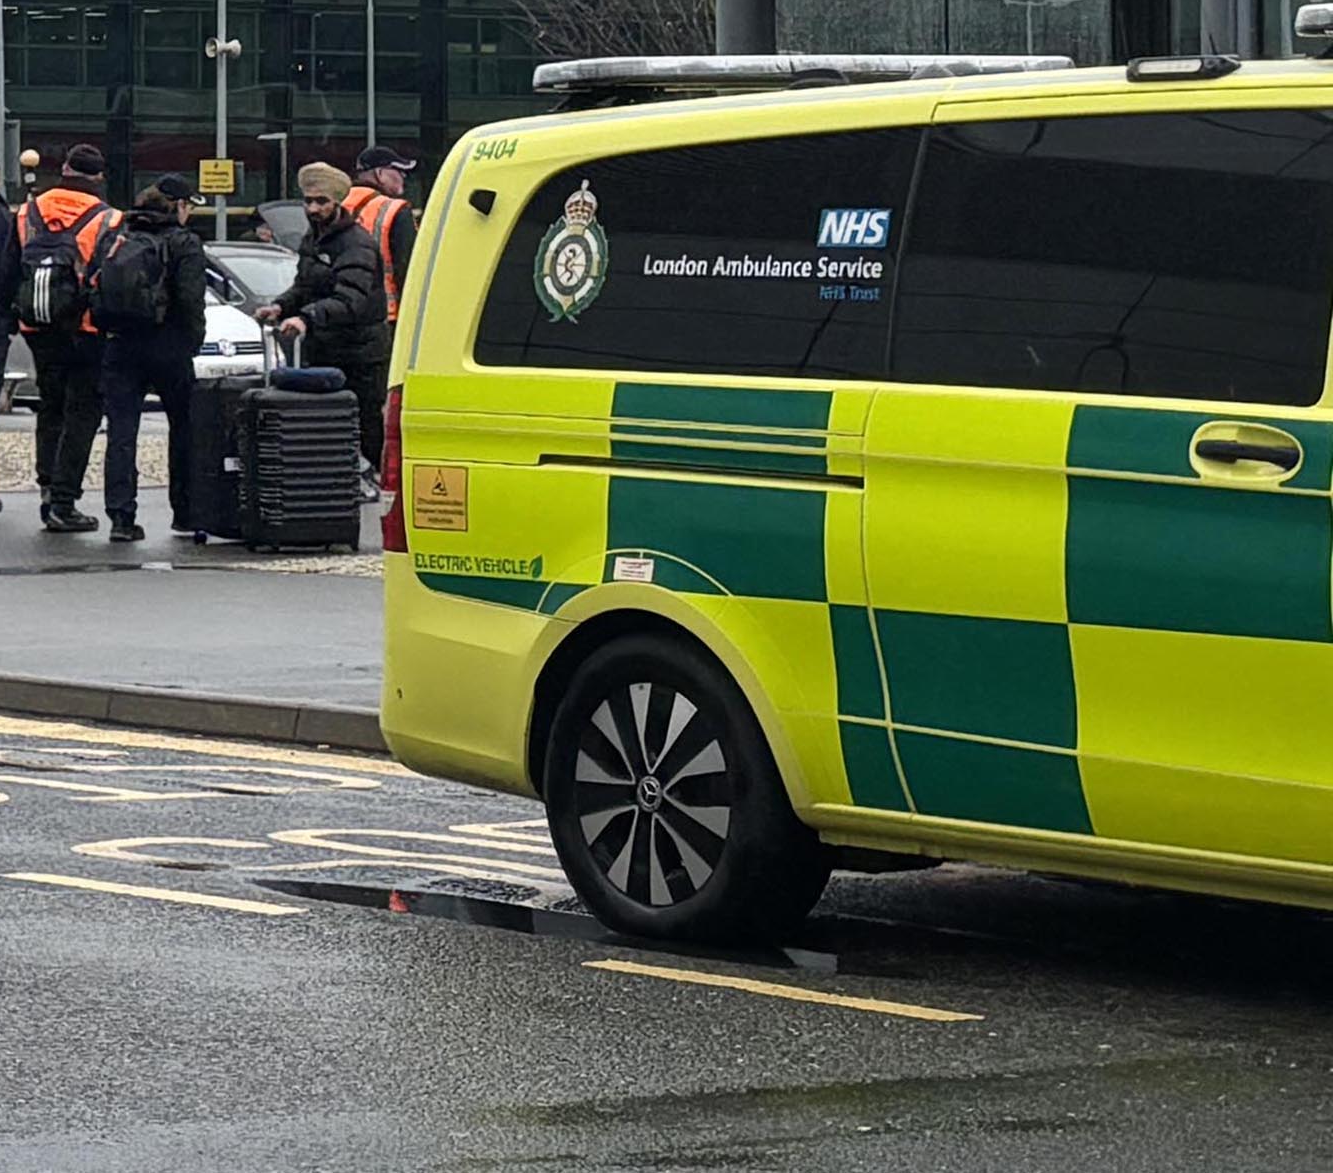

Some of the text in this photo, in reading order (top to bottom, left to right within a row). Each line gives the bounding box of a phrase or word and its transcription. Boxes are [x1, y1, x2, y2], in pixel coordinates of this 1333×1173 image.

[473, 138, 519, 161] 9404
[817, 211, 889, 245] NHS
[643, 254, 883, 279] London Ambulance Service
[819, 284, 879, 301] NHS Trust
[414, 552, 530, 575] ELECTRIC VEHICLE
